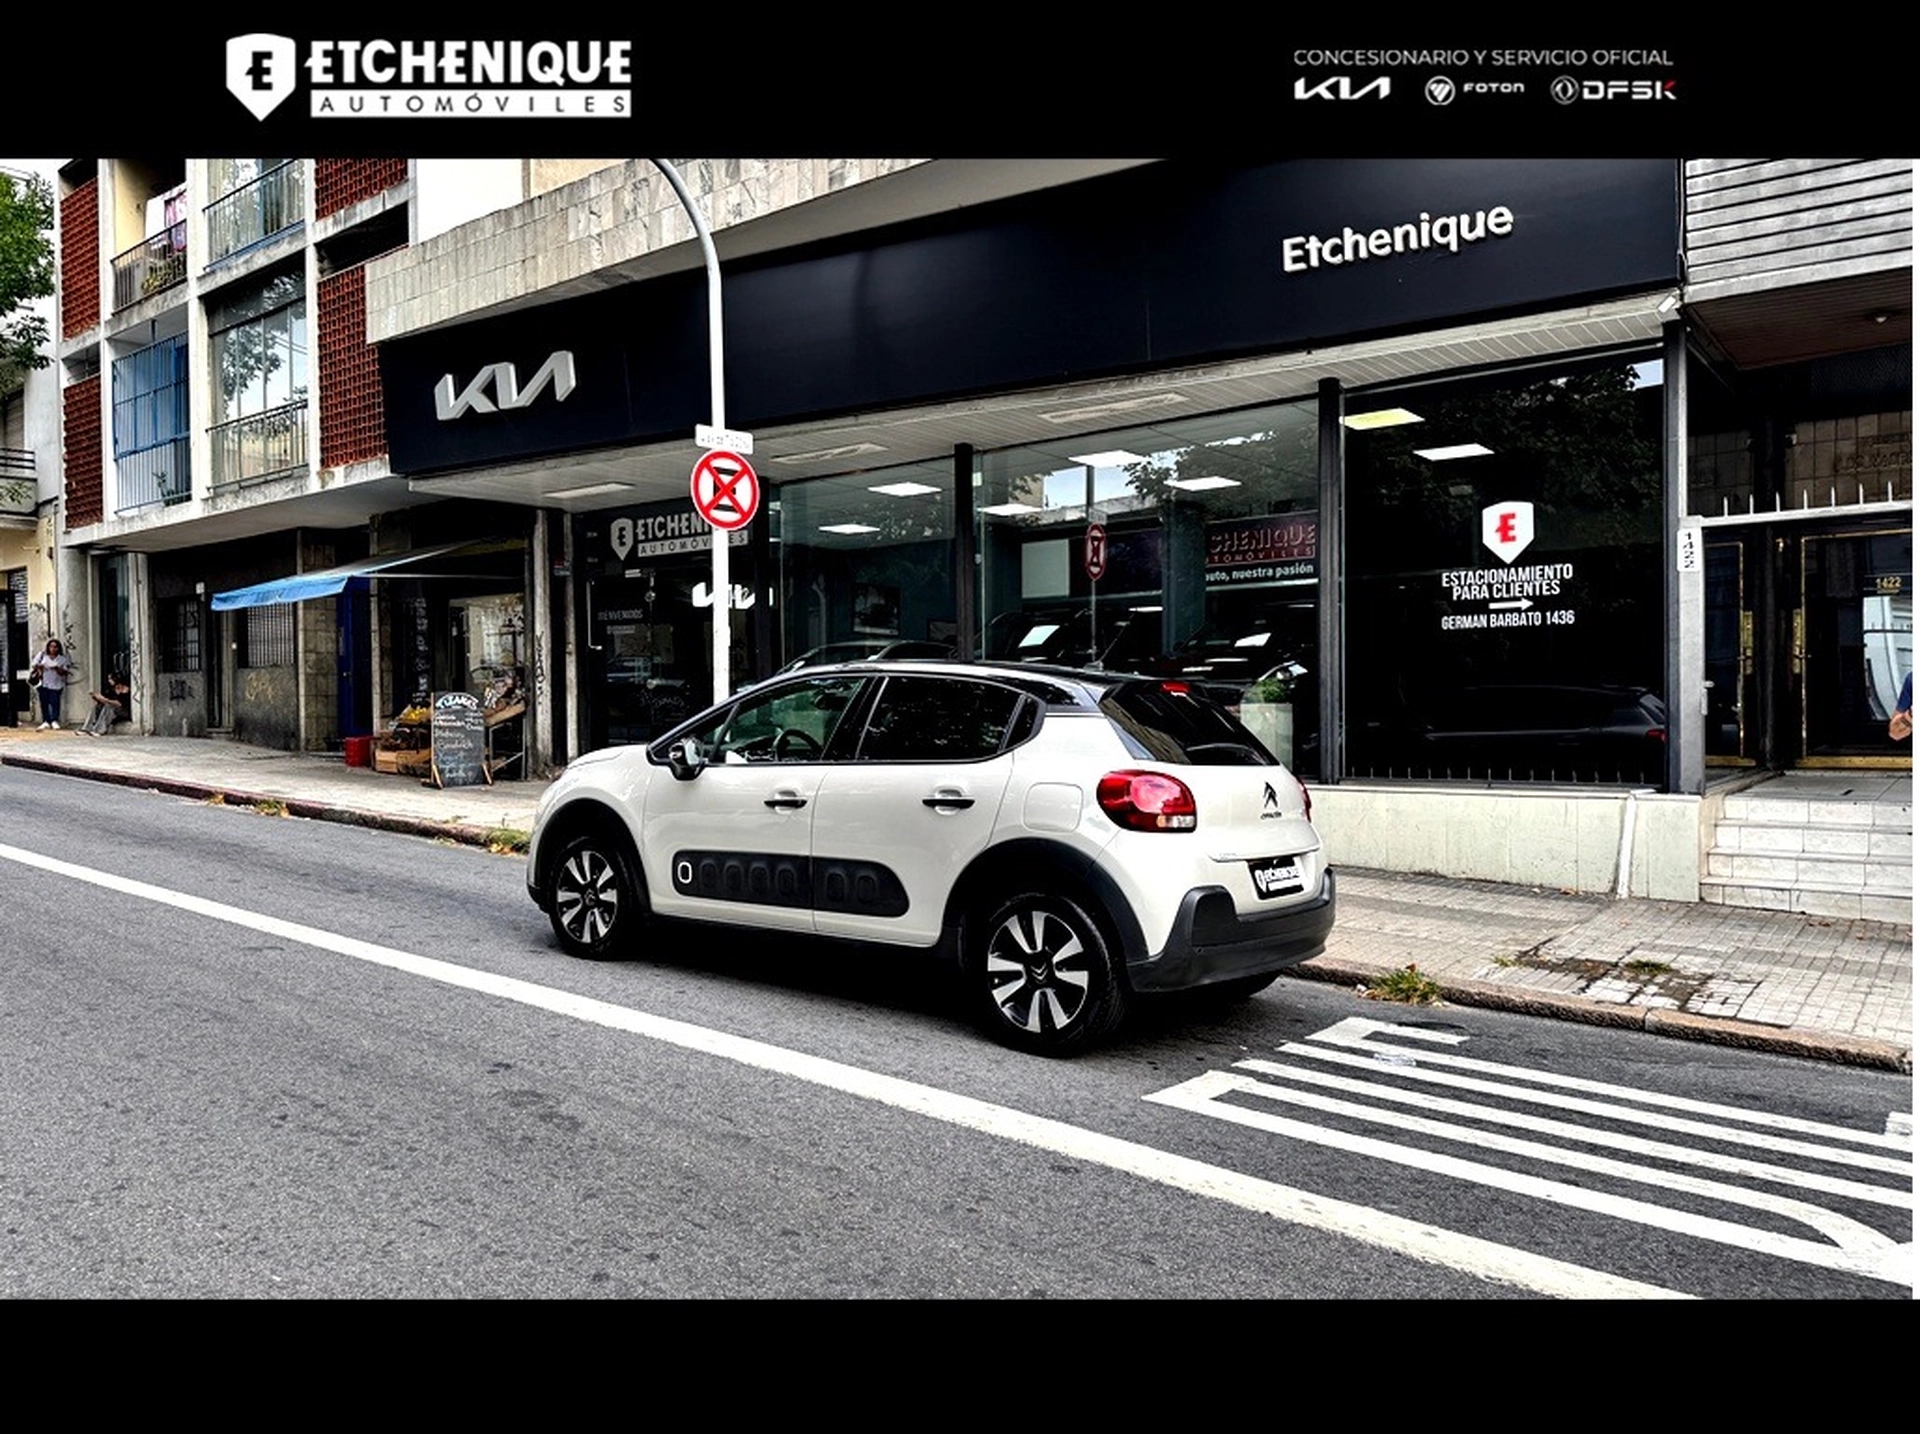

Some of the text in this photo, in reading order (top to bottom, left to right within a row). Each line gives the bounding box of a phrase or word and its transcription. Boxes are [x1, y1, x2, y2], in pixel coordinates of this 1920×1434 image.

[1283, 206, 1514, 272] Etchenique
[434, 350, 576, 420] KIA
[636, 511, 710, 540] ETCHENI
[641, 532, 744, 554] AUTOMÓVES
[1211, 524, 1316, 553] CHENIQUE
[1232, 567, 1273, 579] nuestra
[1275, 562, 1314, 578] pasión
[1442, 564, 1573, 587] ESTACIONAMIENTO
[1453, 580, 1560, 600] PARA CLIENTES
[1875, 577, 1901, 589] 1422
[1441, 610, 1575, 630] GERMAN BARBATO 1436
